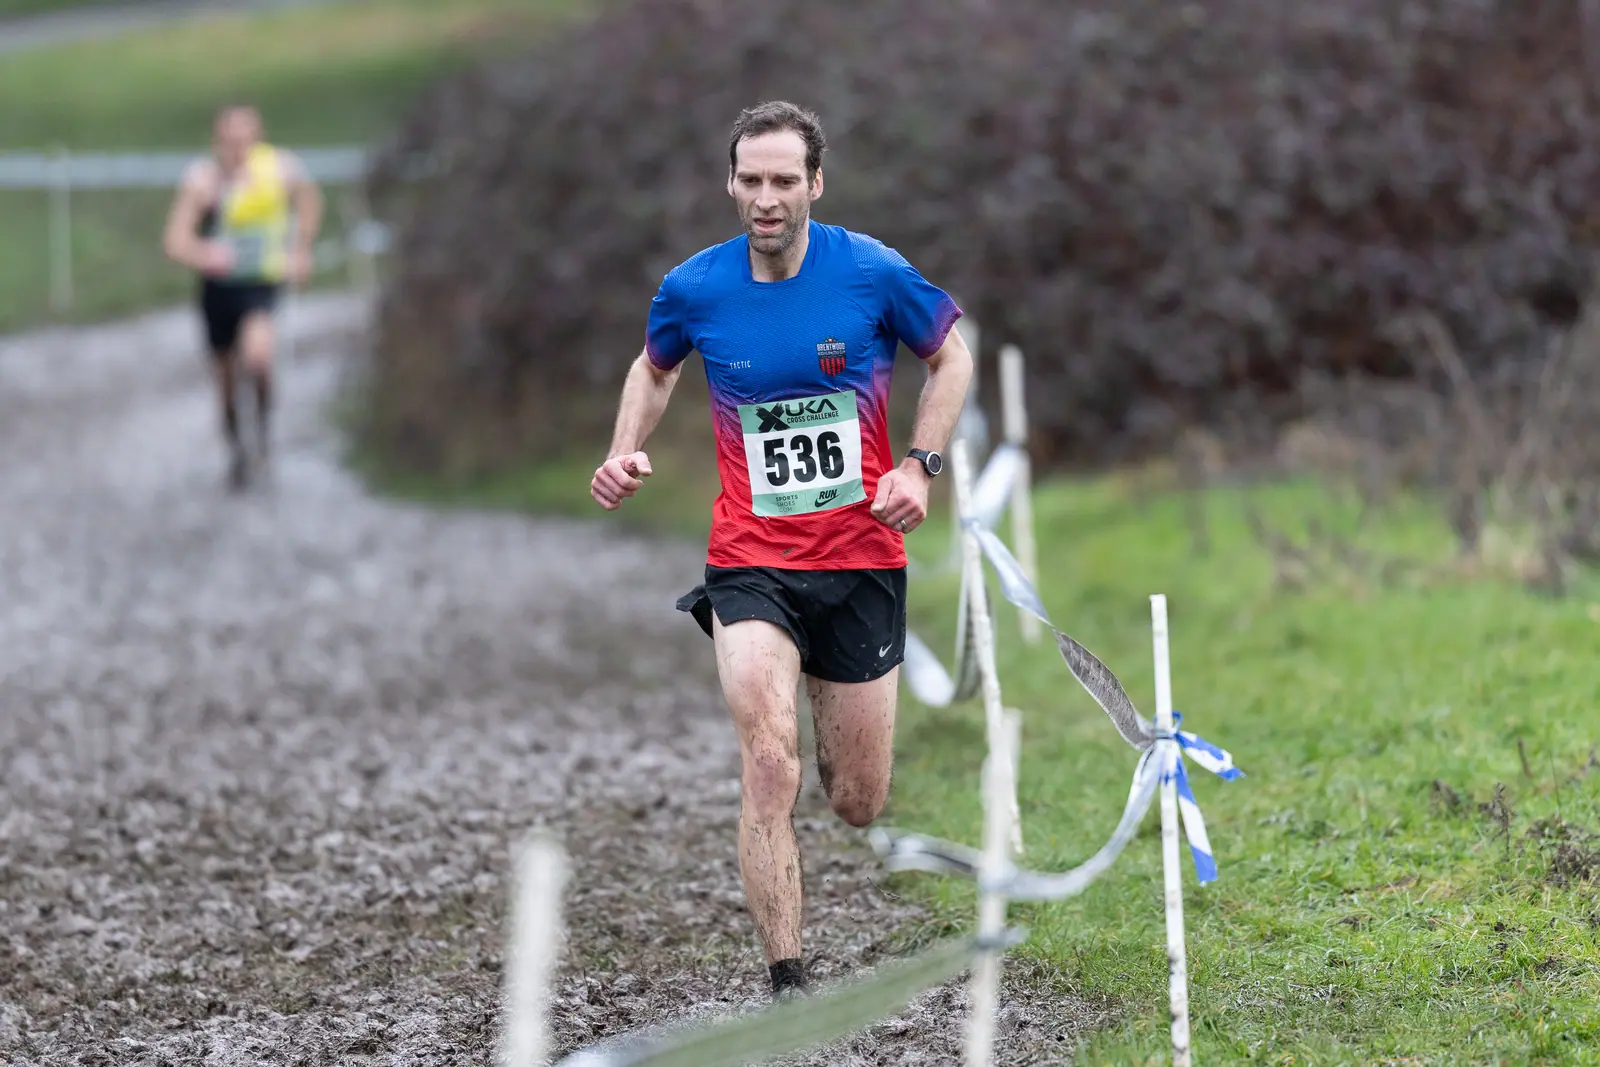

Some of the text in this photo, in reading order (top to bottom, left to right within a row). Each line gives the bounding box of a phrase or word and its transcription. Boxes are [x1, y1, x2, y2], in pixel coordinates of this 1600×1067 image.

[729, 360, 751, 369] TACTIC
[786, 410, 840, 425] CROSS CHALLENGE
[763, 431, 845, 487] 536
[775, 494, 799, 502] SPORTS
[818, 488, 838, 500] RUN
